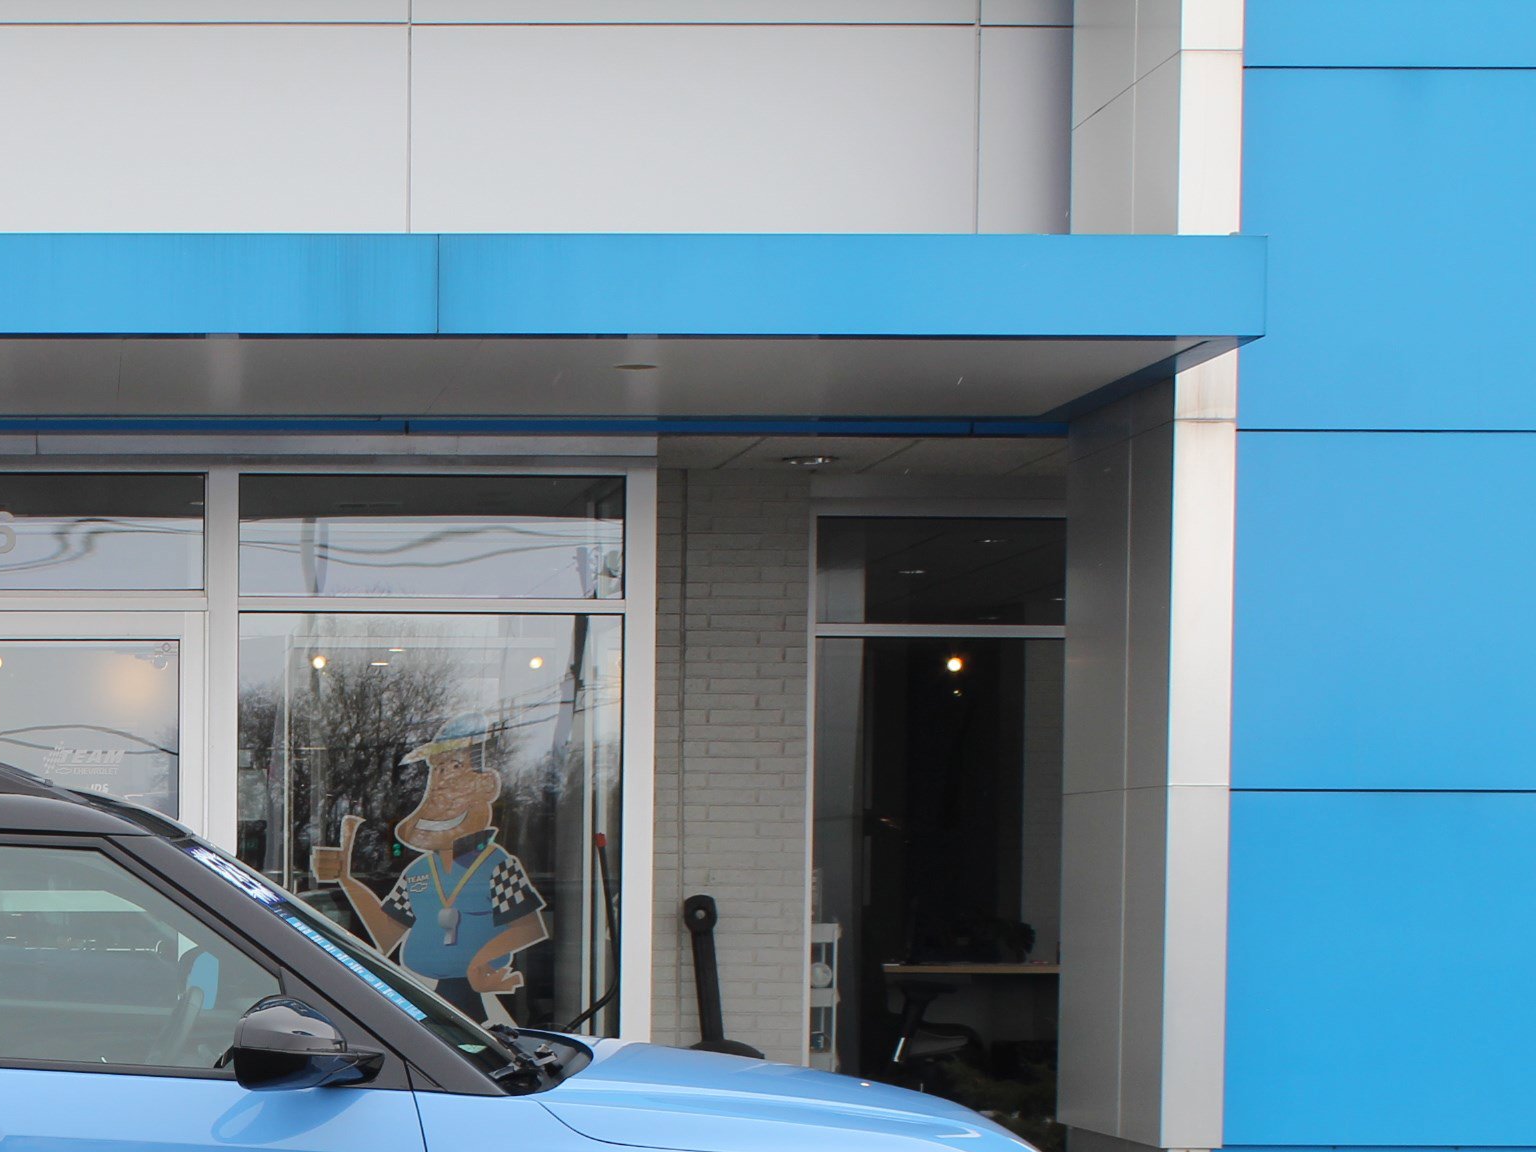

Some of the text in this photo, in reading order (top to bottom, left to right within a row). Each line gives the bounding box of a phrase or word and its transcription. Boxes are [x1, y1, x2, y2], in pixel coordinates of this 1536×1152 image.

[58, 749, 125, 764] TEAM
[73, 767, 119, 775] CHEVROLET
[407, 874, 431, 883] TEAM
